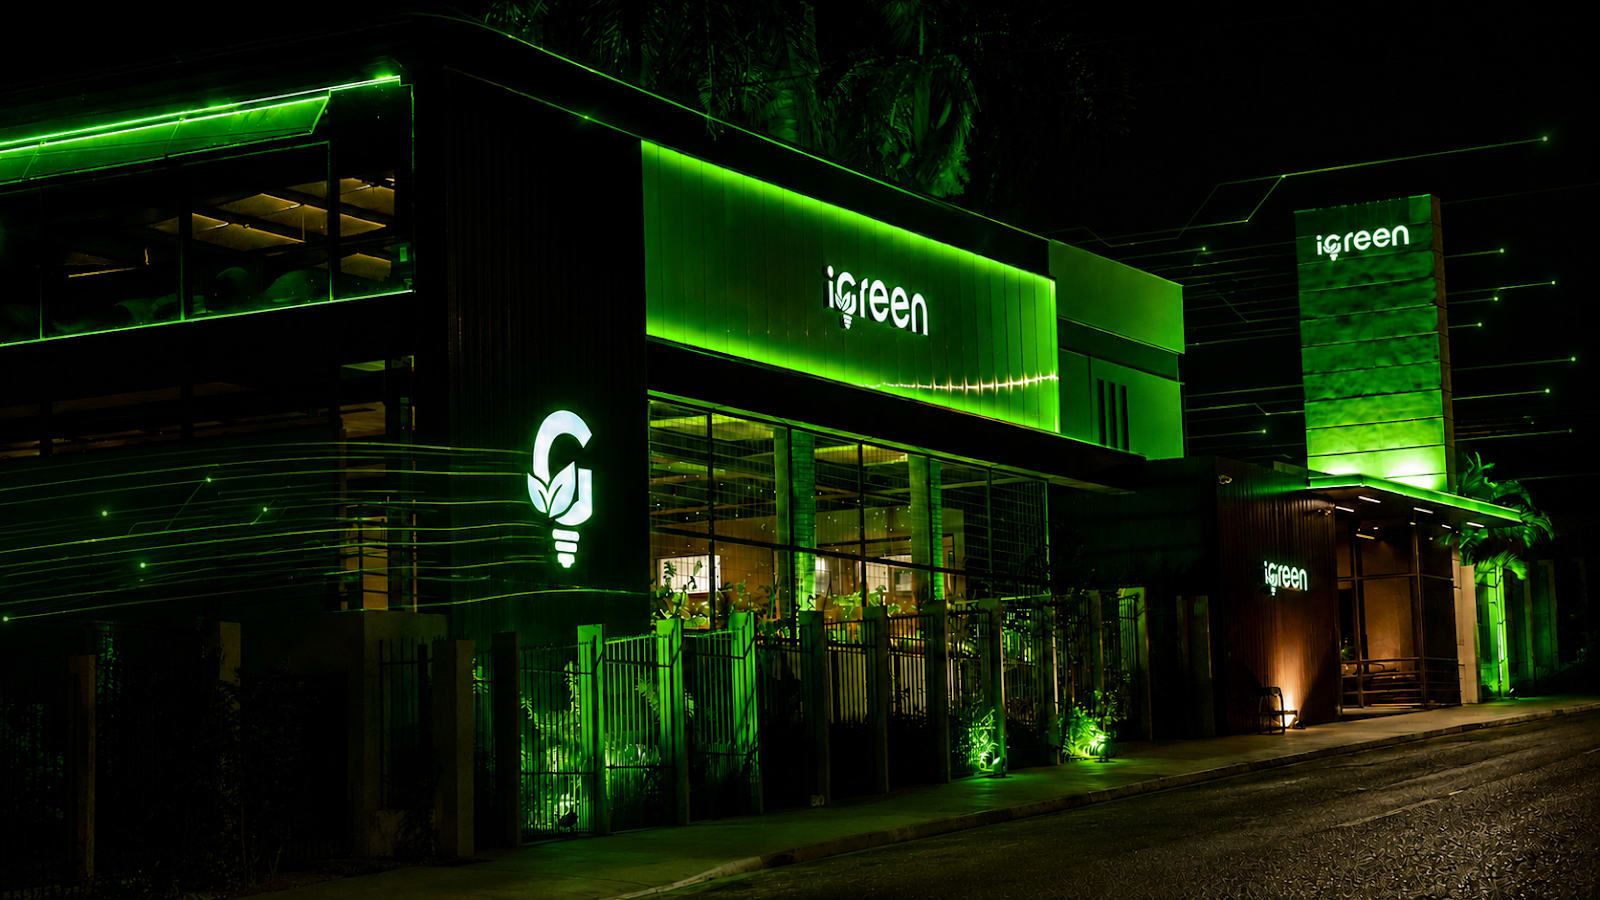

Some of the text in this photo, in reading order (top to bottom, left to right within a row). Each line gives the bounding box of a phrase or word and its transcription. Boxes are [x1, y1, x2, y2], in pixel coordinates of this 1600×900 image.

[1316, 225, 1410, 262] iGreen
[827, 265, 929, 336] iGreen
[1263, 560, 1308, 596] iGreen
